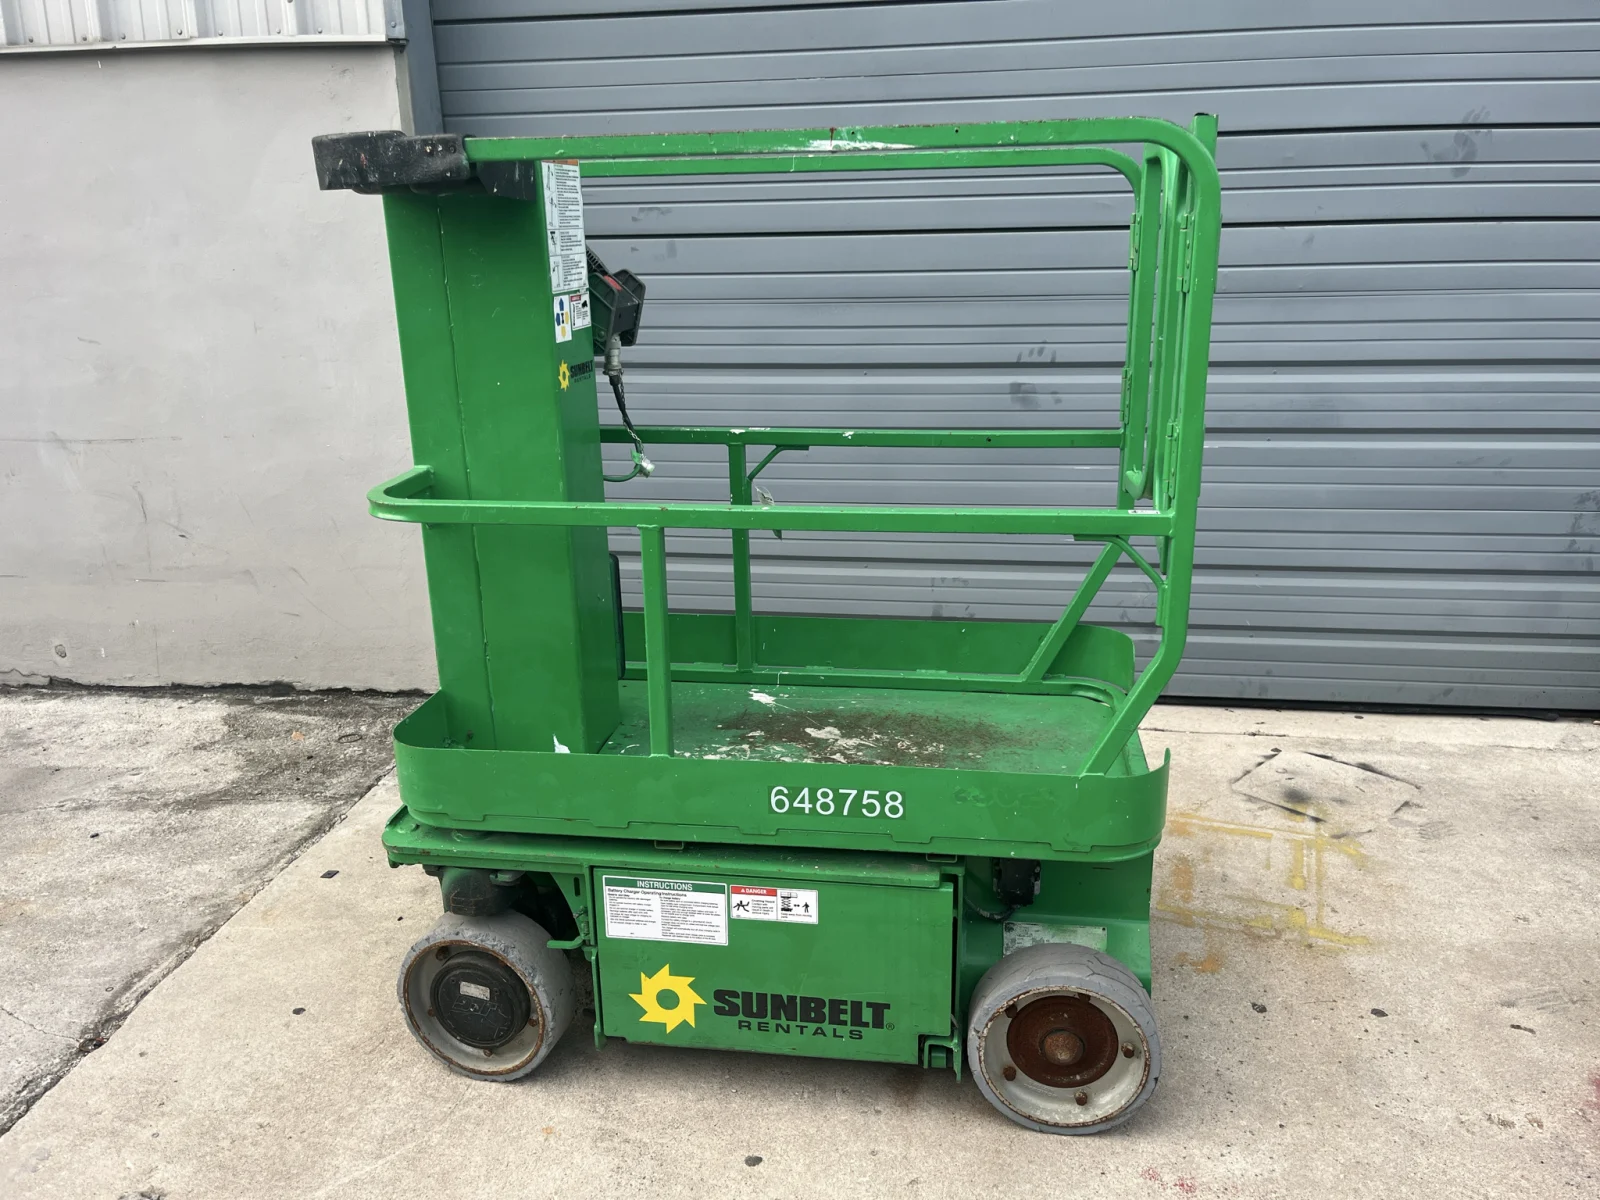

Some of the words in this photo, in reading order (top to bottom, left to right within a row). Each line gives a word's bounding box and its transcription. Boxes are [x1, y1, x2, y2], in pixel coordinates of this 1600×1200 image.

[570, 360, 593, 378] SUNBELT
[770, 786, 904, 819] 648758
[637, 880, 693, 891] INSTRUCTIONS
[713, 989, 891, 1029] SUNBELT
[738, 1020, 863, 1040] RENTALS
